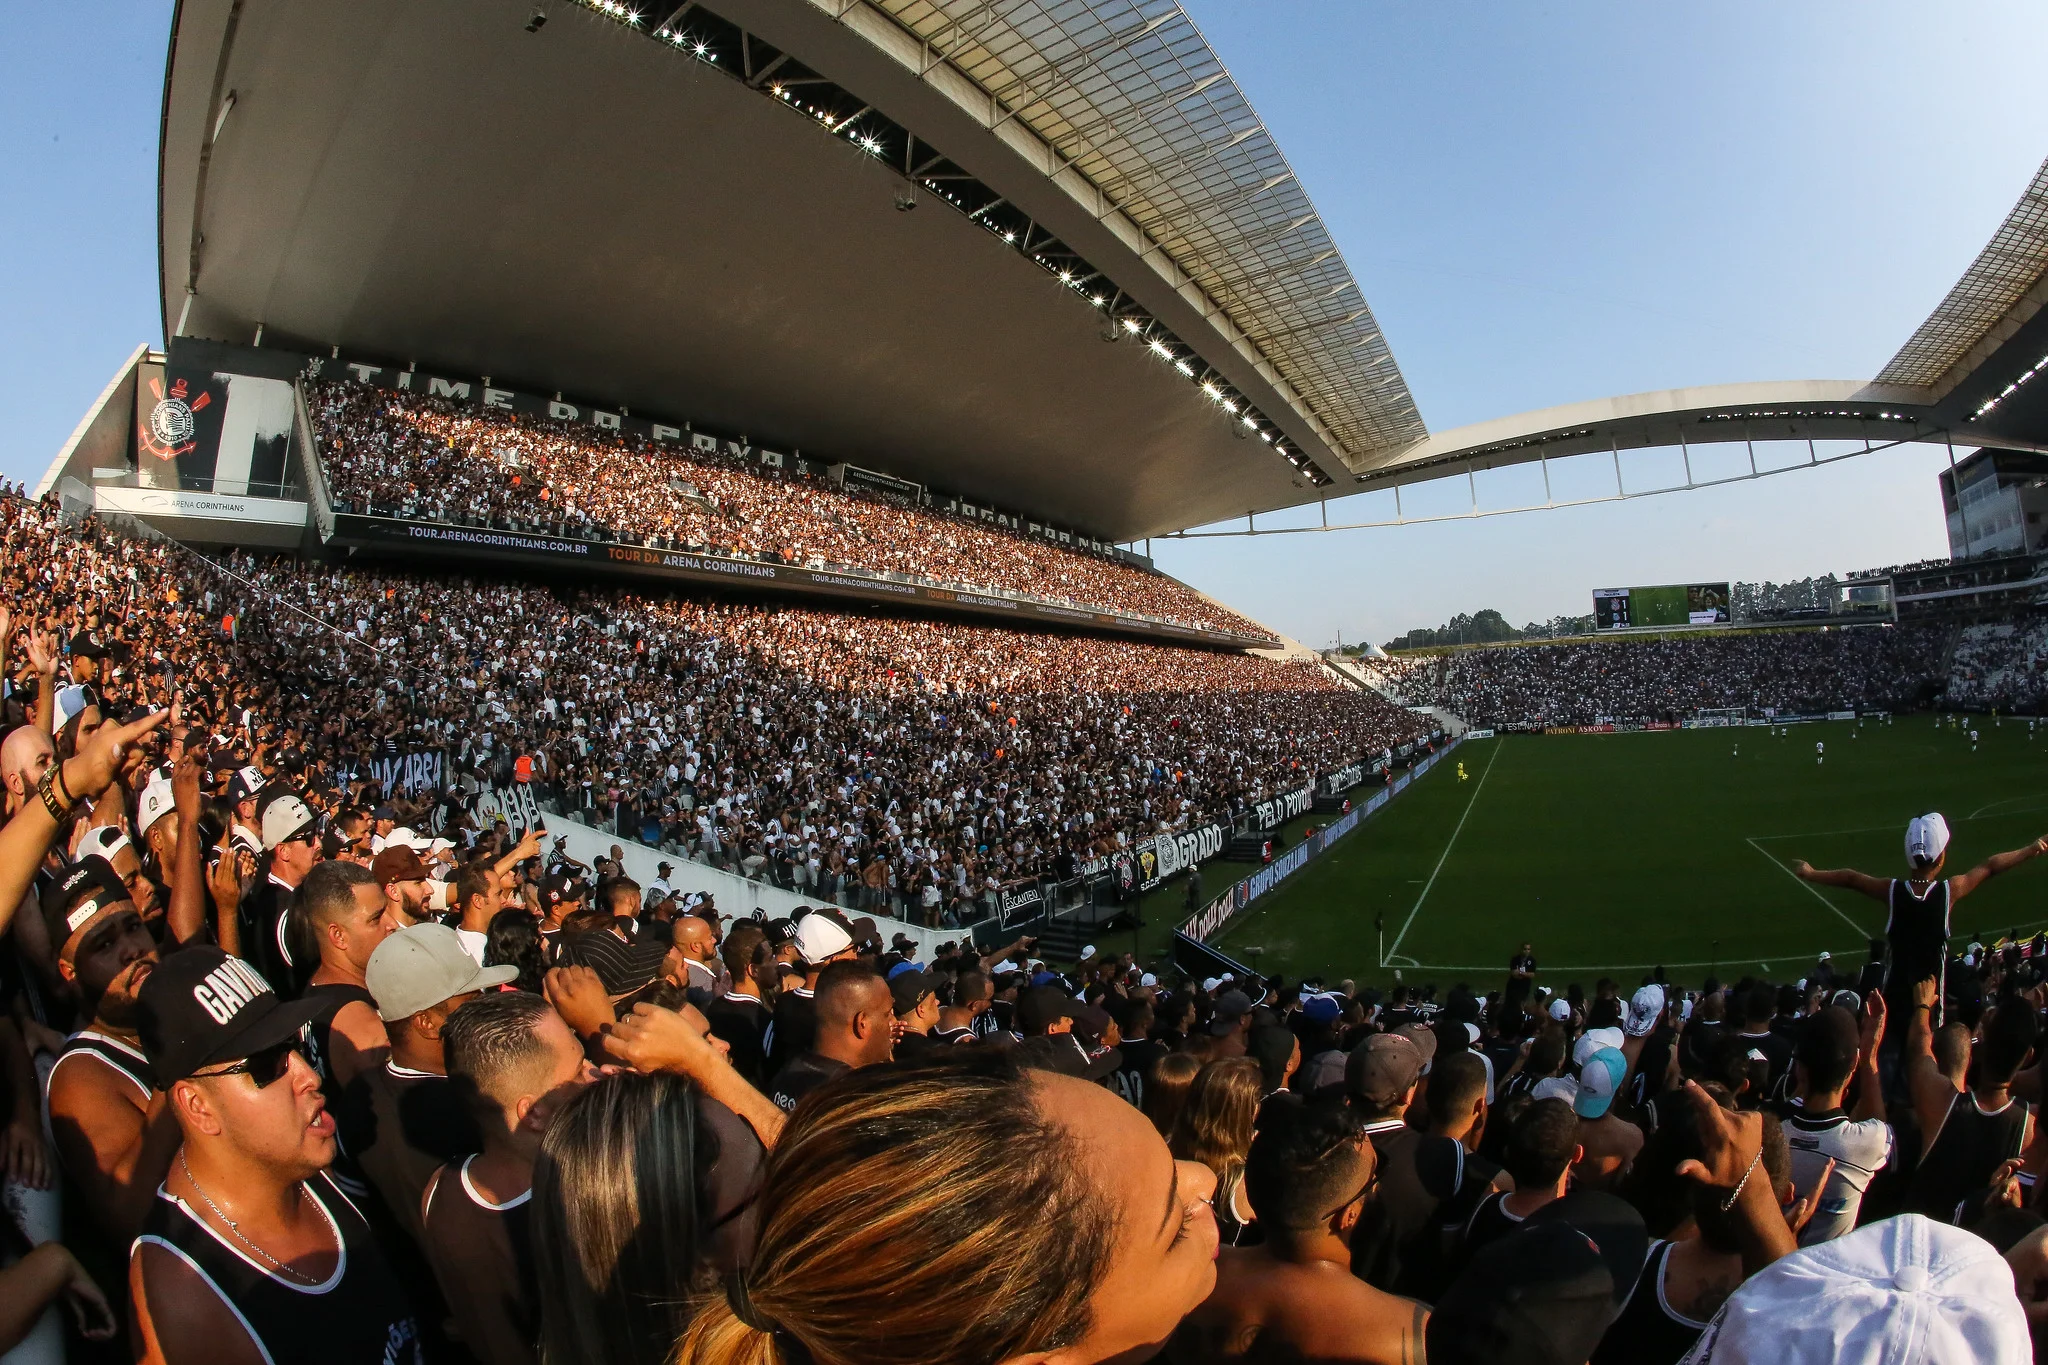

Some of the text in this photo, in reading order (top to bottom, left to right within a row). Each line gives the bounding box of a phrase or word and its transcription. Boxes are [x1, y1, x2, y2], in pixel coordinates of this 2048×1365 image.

[348, 362, 784, 468] TIME DO POVO
[171, 500, 245, 512] ARENA CORINTHIANS
[408, 526, 588, 554] TOUR.ARENACORINTHIANS.COM.BR
[608, 547, 776, 578] TOUR DA ARENA CORINTHIANS
[811, 573, 916, 594] TOUR.ARENACORINTHIANS.COM.BR
[926, 589, 945, 599] TOUR
[956, 594, 977, 604] ARENA
[978, 597, 1018, 610] CORINTHIANS
[1621, 599, 1627, 610] 1
[1622, 611, 1628, 621] 1
[1578, 725, 1604, 733] ASKOV
[1256, 788, 1307, 830] PELO POVO
[1250, 842, 1308, 901] GRUPO SOUZA LIMA
